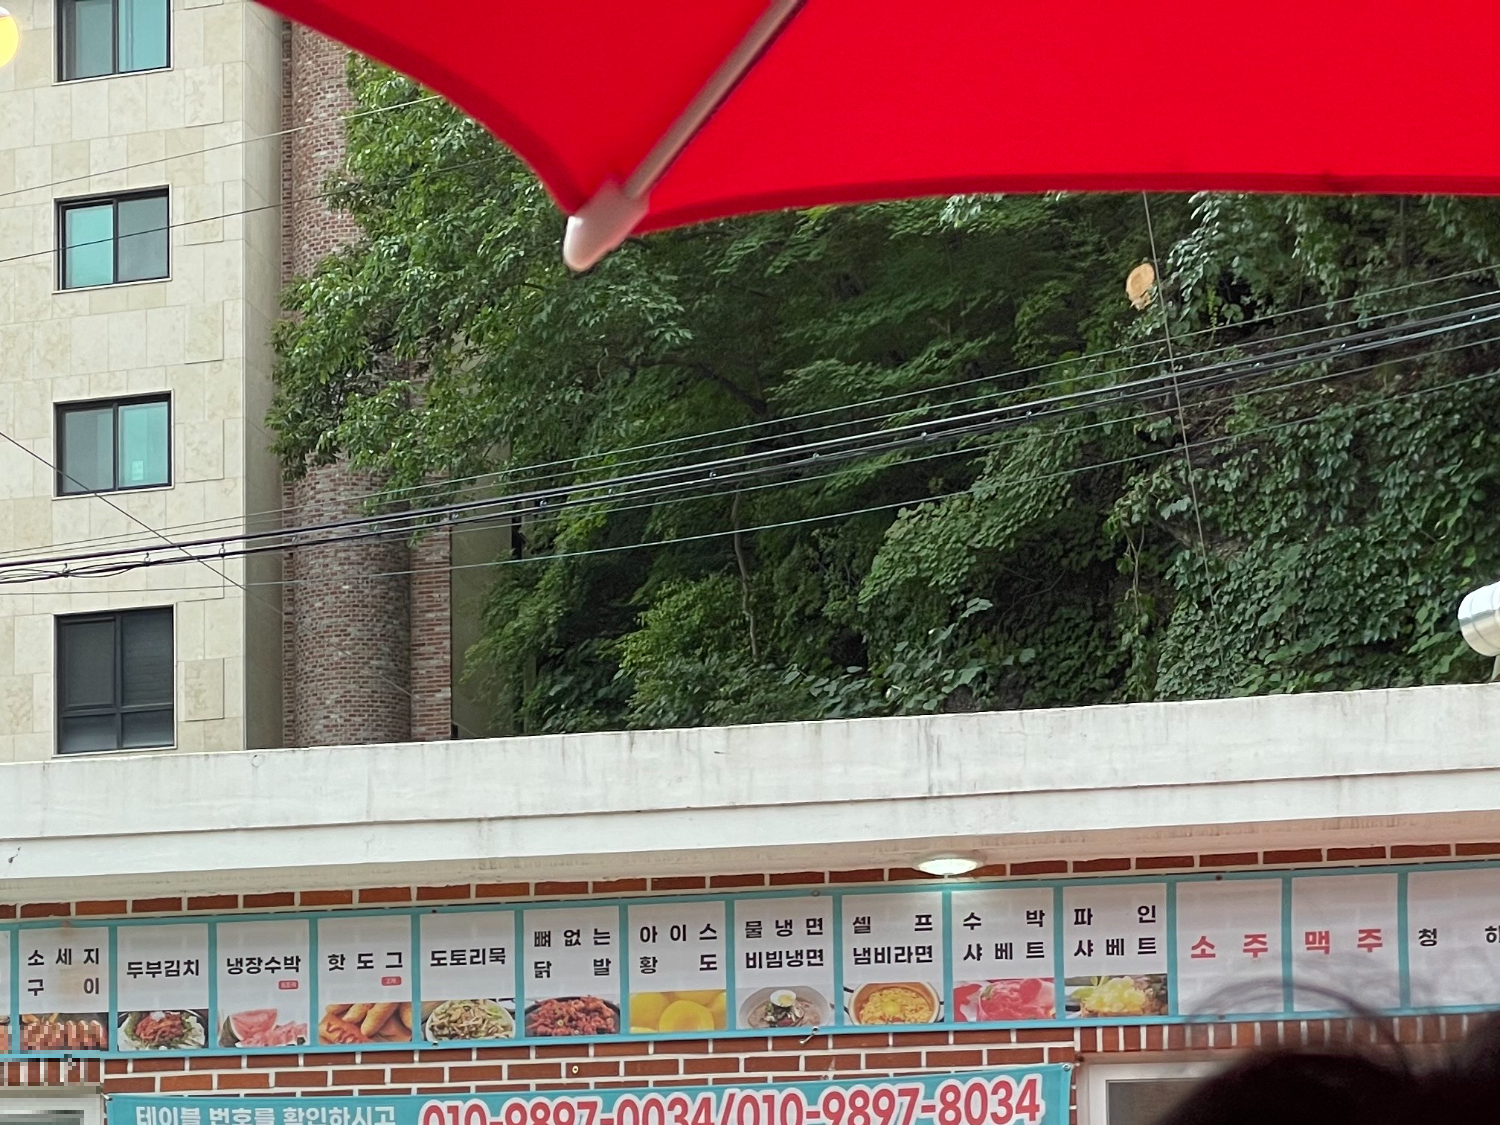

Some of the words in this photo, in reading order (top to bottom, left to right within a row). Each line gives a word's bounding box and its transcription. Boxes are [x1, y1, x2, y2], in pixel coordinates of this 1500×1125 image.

[852, 914, 933, 935] 셀프
[963, 909, 1046, 931] 수박
[1073, 904, 1156, 926] 파인
[534, 928, 611, 948] 뼈없는
[639, 923, 718, 943] 아이스
[745, 917, 823, 939] 물냉면
[27, 947, 99, 966] 소세지
[430, 947, 506, 967] 도토리묵
[853, 945, 933, 965] 냄비라면
[963, 941, 1045, 962] 샤베트
[1073, 937, 1157, 957] 샤베트
[226, 955, 301, 975] 냉장수박
[327, 951, 403, 972] 핫도그
[534, 958, 612, 979] 닭발
[639, 953, 718, 975] 황도
[745, 948, 824, 969] 비빔냉면
[126, 959, 199, 979] 두부김치
[27, 977, 100, 997] 구이
